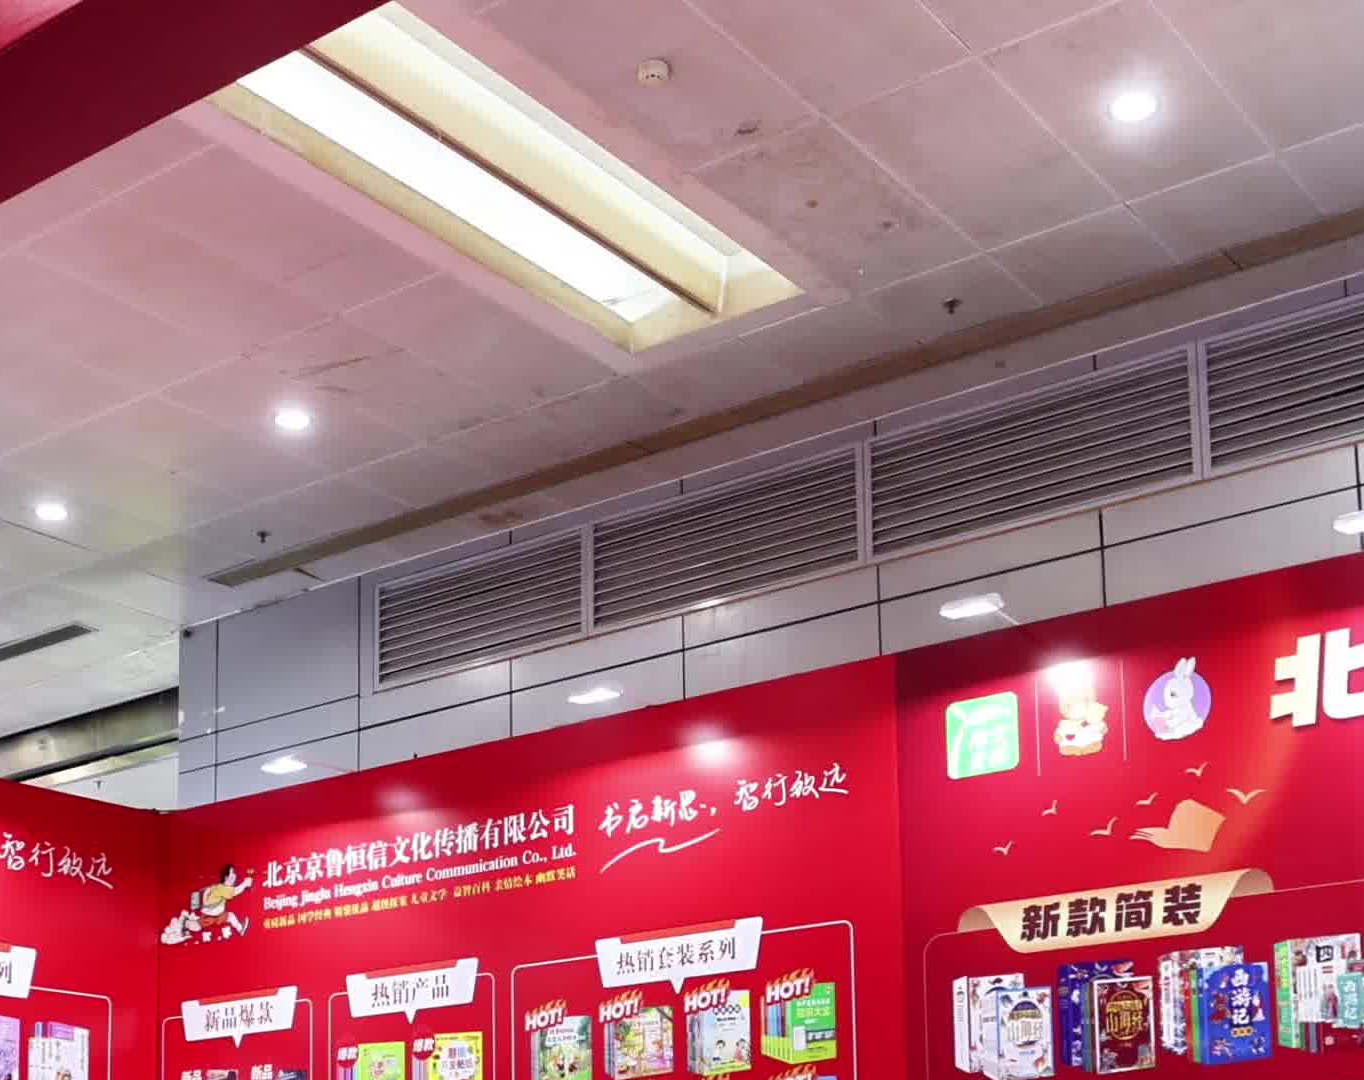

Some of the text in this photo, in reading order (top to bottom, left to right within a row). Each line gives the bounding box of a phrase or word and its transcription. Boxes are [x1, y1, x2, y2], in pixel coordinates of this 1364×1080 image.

[263, 804, 575, 888] 北京京鲁恒信文化传播有限公司
[264, 892, 299, 912] Beijing
[382, 871, 422, 890] Culture
[426, 855, 518, 882] Communication
[522, 849, 548, 866] Co.,
[552, 843, 577, 860] Ltd.
[1020, 882, 1205, 943] 新款简装
[616, 937, 737, 976] 热销套装系列
[371, 974, 450, 1008] 热销产品
[684, 988, 728, 1013] HOT!
[766, 976, 811, 1003] HOT!
[1231, 969, 1253, 1025] 西游记
[203, 1003, 274, 1032] 新品爆款
[525, 1007, 565, 1031] HOT!
[599, 998, 641, 1022] HOT!
